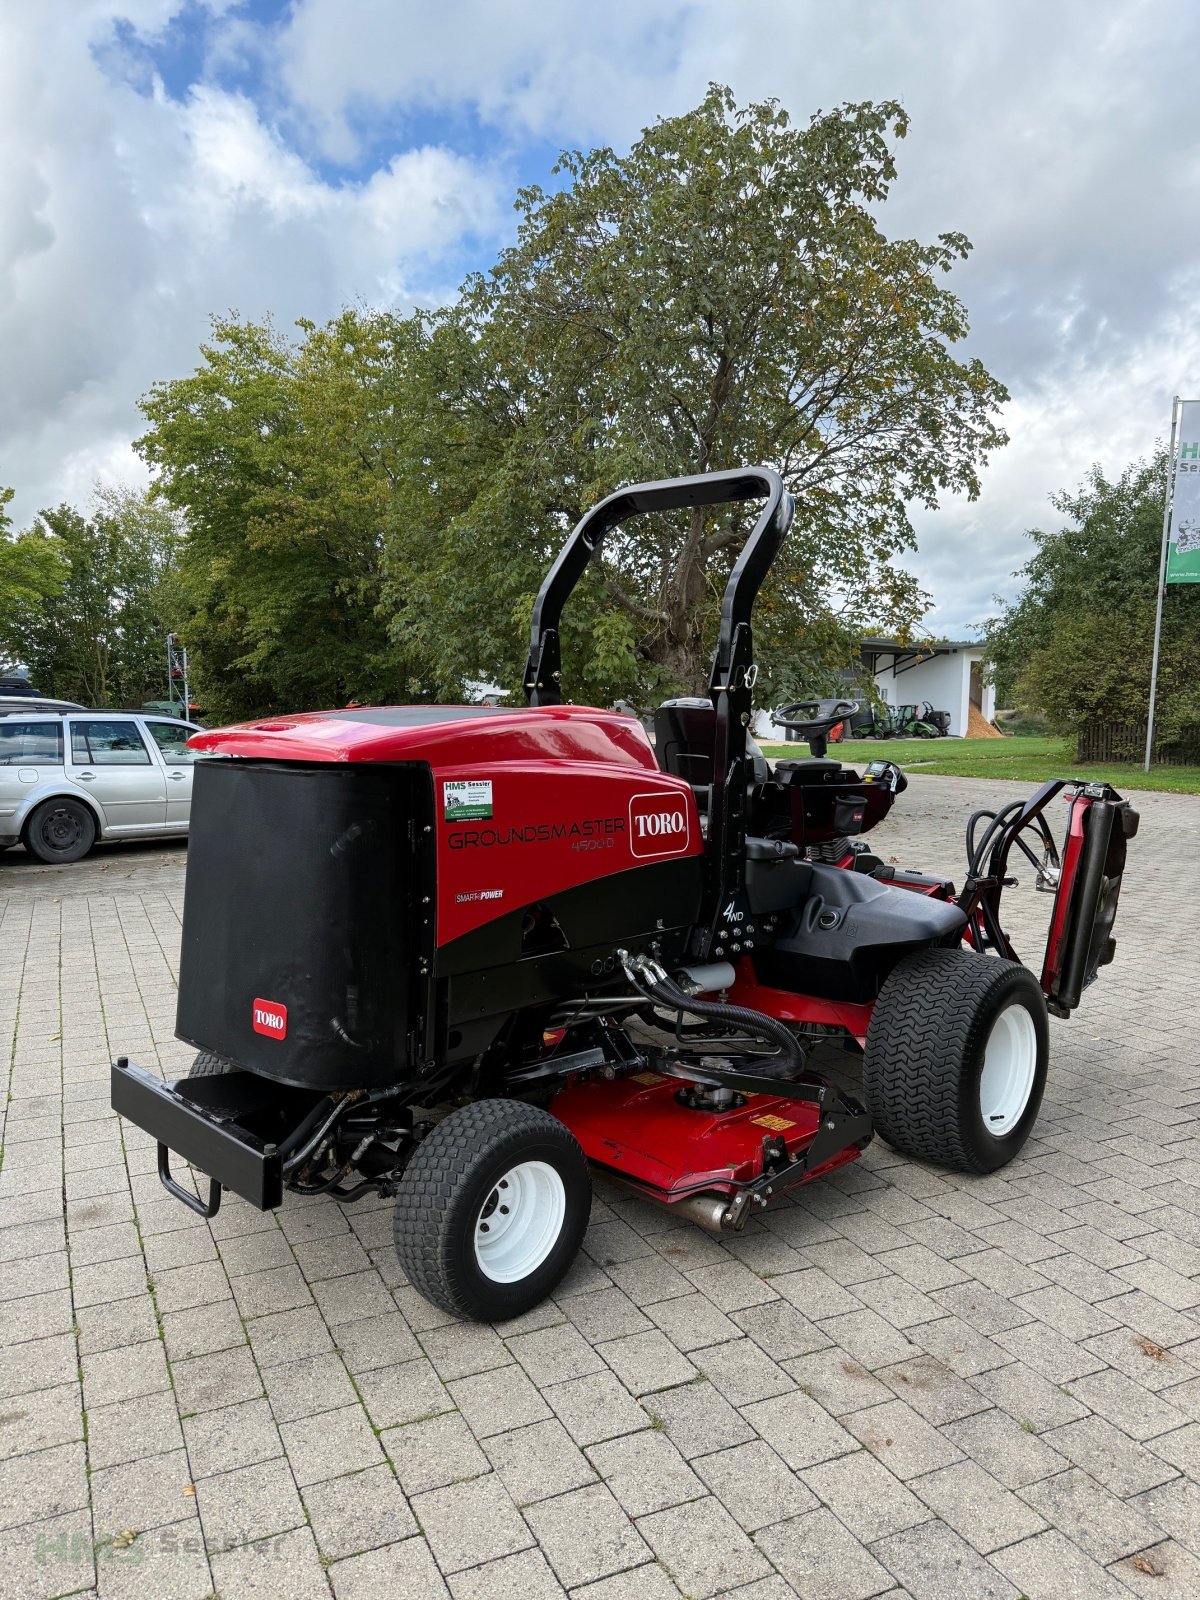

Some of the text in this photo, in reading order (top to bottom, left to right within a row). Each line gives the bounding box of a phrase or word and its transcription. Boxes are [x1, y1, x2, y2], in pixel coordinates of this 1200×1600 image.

[1181, 442, 1200, 459] H
[1180, 462, 1200, 473] Se
[445, 782, 466, 791] HMS
[448, 817, 625, 849] GROUNDSMASTER
[634, 811, 684, 838] TORO
[722, 900, 744, 923] 4WD
[255, 1009, 284, 1030] TORO
